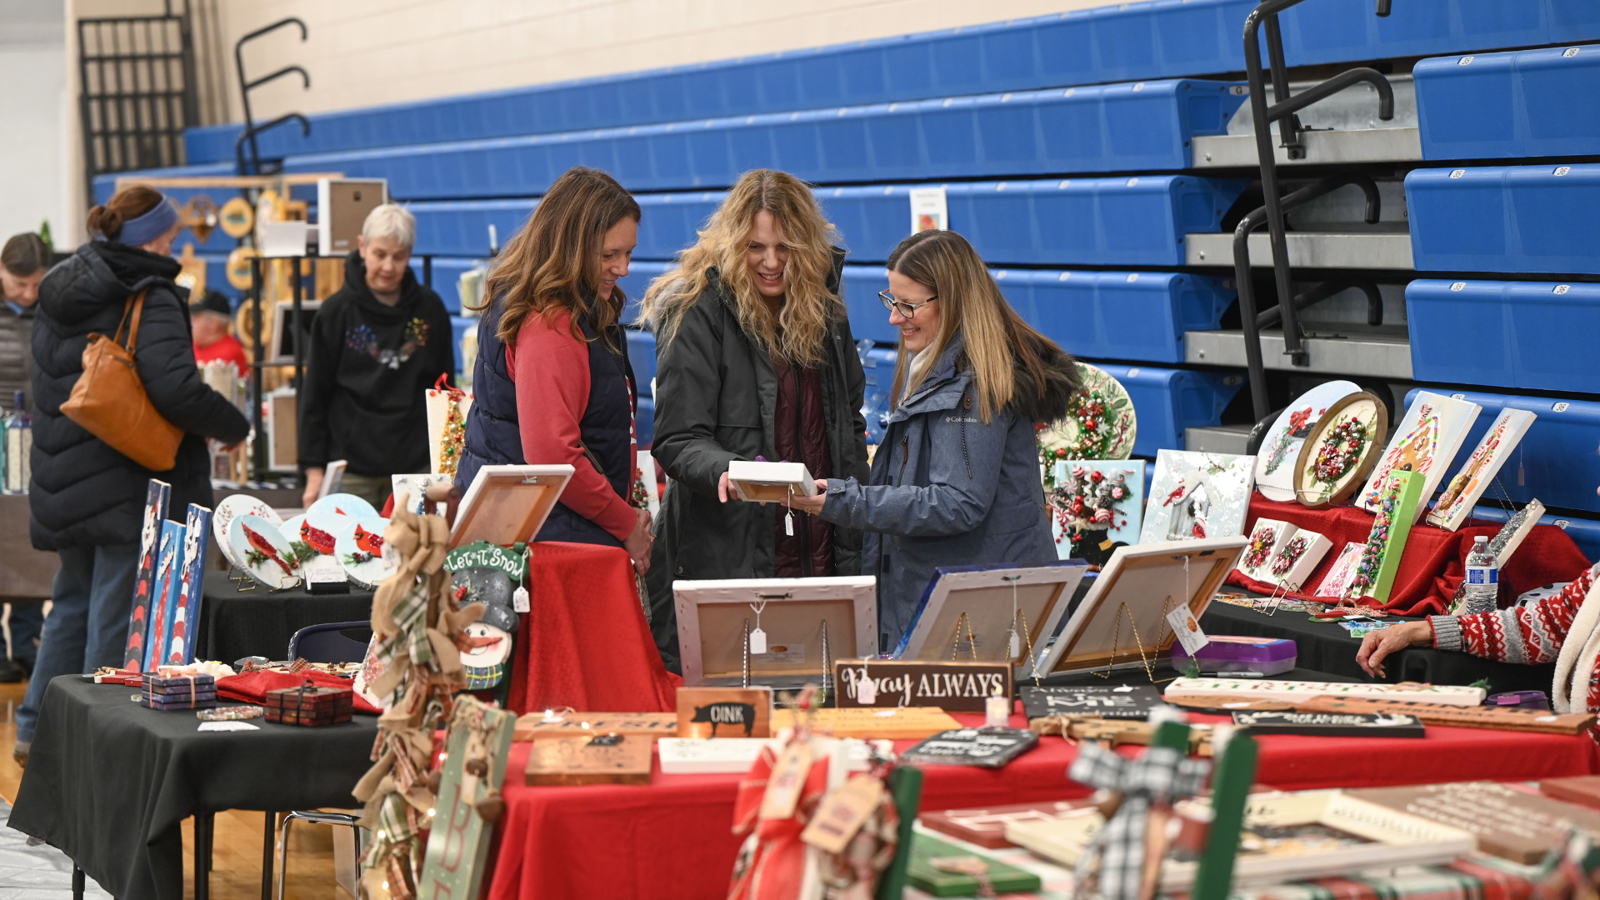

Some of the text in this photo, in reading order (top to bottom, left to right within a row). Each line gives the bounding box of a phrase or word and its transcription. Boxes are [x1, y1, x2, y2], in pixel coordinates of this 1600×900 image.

[1235, 85, 1243, 95] G
[446, 547, 523, 577] Let it Snow
[916, 672, 1004, 698] ALWAYS
[710, 704, 745, 723] OINK
